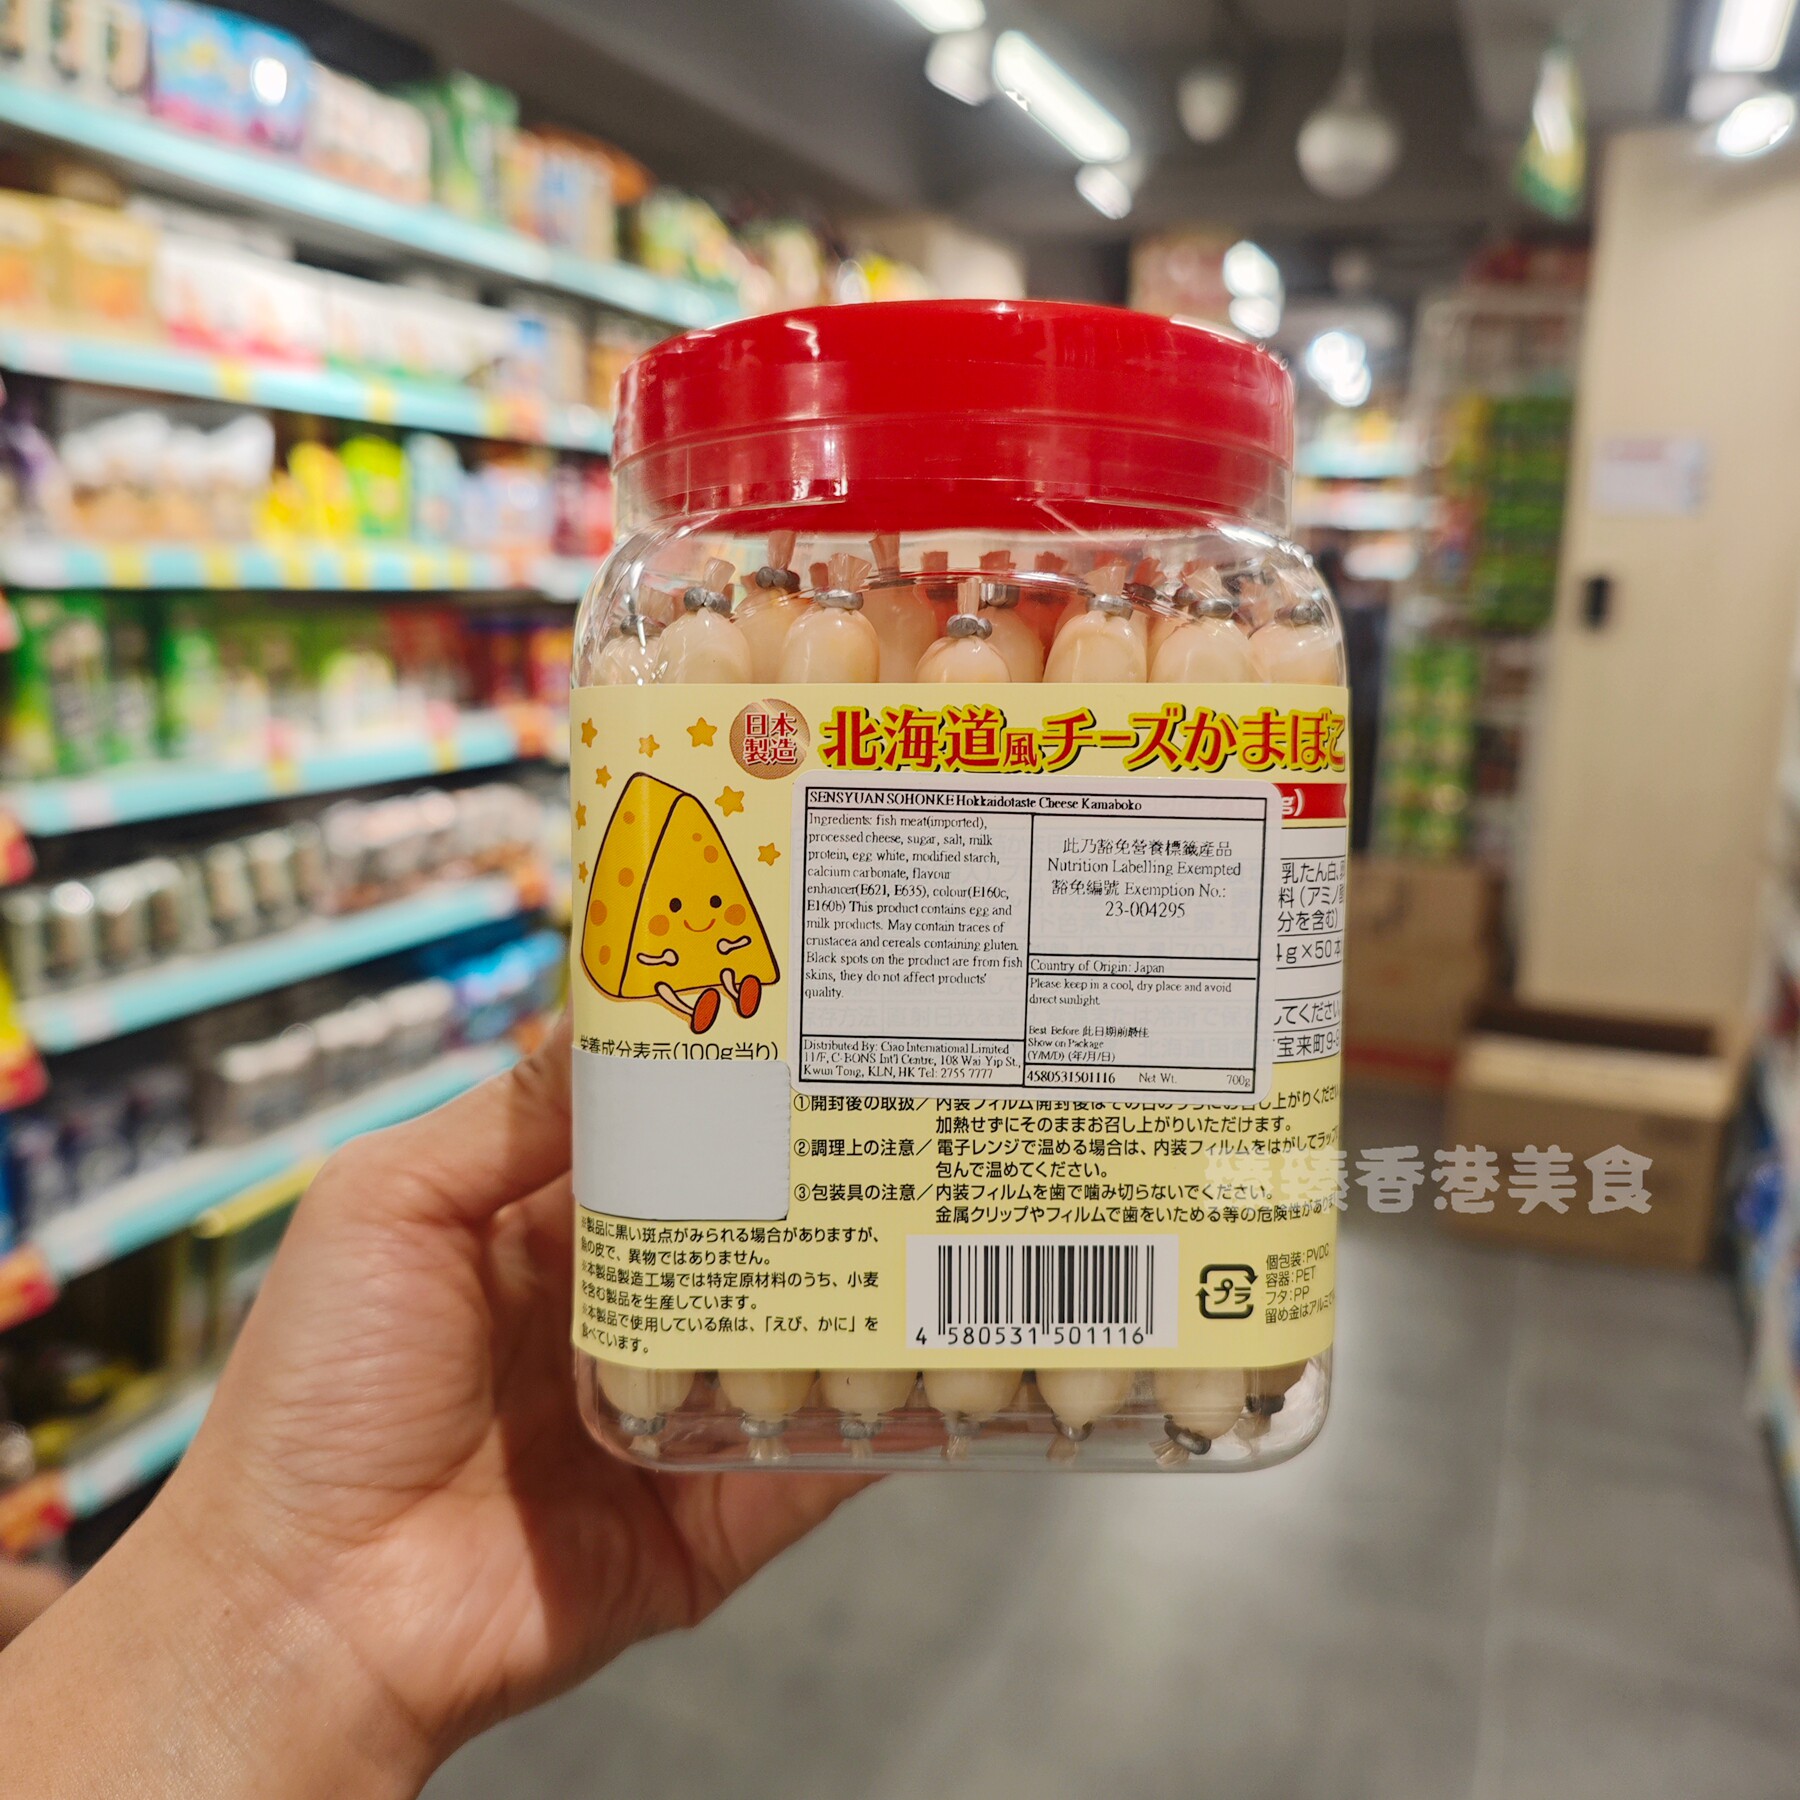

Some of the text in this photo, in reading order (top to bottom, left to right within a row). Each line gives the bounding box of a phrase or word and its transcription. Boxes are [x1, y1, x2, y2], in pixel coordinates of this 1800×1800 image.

[745, 712, 798, 738] 日本
[744, 739, 798, 765] 製造
[810, 791, 1142, 810] SENSYUAN SOHONKE Hokkaidotaste Cheese Kamaboko
[876, 814, 896, 826] fish
[901, 816, 987, 829] meat(imported),
[809, 832, 992, 847] processed cheese, sugar, salt, milk
[808, 850, 1000, 865] protein, egg white, modified starch,
[808, 867, 951, 880] calcium carbonate, flavour
[1048, 858, 1241, 877] Nutrition Labelling Exempted
[807, 883, 1009, 900] enhancer(E621, E635), colour(E160c,
[1052, 879, 1226, 898] 豁免編號 Exemption No.:
[807, 900, 1012, 917] E160b) This product contains egg and
[1105, 901, 1185, 918] 23-004295
[807, 918, 1005, 933] milk products. May contain traces of
[806, 936, 856, 947] crustacea
[860, 937, 879, 948] and
[882, 938, 920, 949] cereals
[924, 939, 980, 952] containing
[806, 951, 1023, 968] Black spots on the product are from fish
[1031, 959, 1164, 975] Country of Origin: Japan
[805, 970, 836, 982] skins,
[840, 971, 863, 982] they
[866, 972, 881, 981] do
[883, 972, 900, 982] not
[904, 972, 935, 983] affect
[805, 986, 844, 999] quality.
[1030, 979, 1061, 989] Please
[1064, 979, 1087, 991] keep
[1090, 980, 1099, 989] in
[1110, 980, 1134, 992] cool,
[1137, 981, 1153, 993] dry
[1156, 981, 1182, 993] place
[1185, 981, 1201, 992] and
[1204, 982, 1231, 992] avoid
[1029, 995, 1057, 1004] direct
[1029, 1026, 1149, 1038] Best Before 此日期前最佳
[804, 1038, 1009, 1054] Distributed By: Ciao International Limited
[1028, 1038, 1052, 1047] Show
[1068, 1039, 1104, 1049] Package
[831, 1052, 876, 1063] C-BONS
[901, 1054, 936, 1066] Centre,
[940, 1055, 958, 1065] 108
[962, 1056, 981, 1066] Wai
[985, 1057, 1003, 1068] Yip
[1028, 1051, 1064, 1061] (Y/M/D)
[804, 1066, 992, 1079] Kwun Tong, KLN, HK Tel: 2755 7777
[1027, 1070, 1250, 1087] 4580531501116 Net Wt. 700g
[935, 1116, 1291, 1134] 加熱せずにそのままお召し上がりいただけます。
[935, 1161, 1108, 1179] 包んで温めてください。
[935, 1183, 1273, 1201] 内装フィルムを歯で噛み切らないでください。
[1265, 1265, 1316, 1288] 容器:PET
[1213, 1278, 1251, 1306] プラ
[1265, 1286, 1310, 1306] フタ:PP
[916, 1328, 1144, 1345] 4 580531 501116
